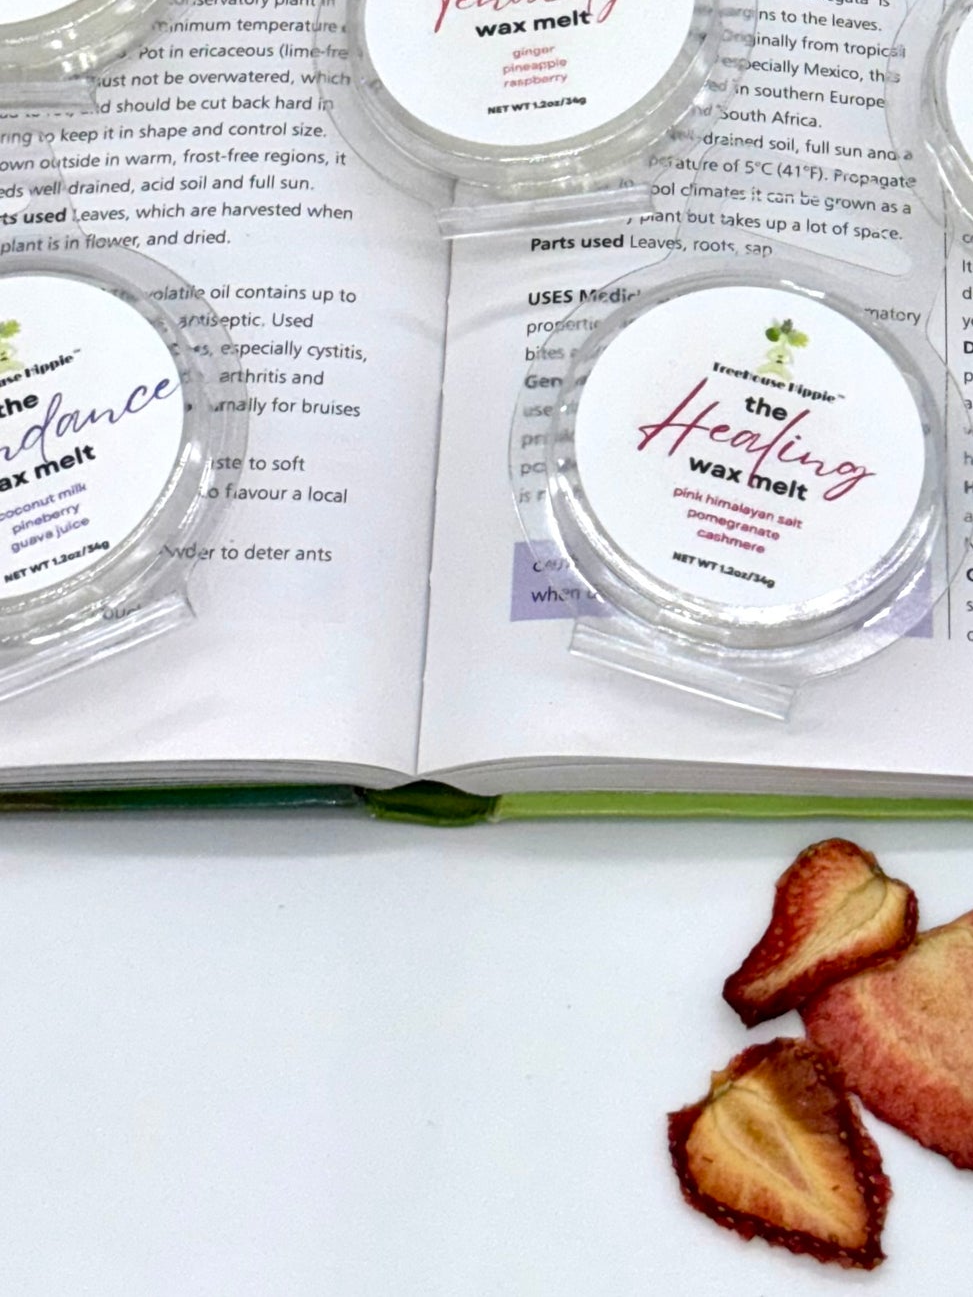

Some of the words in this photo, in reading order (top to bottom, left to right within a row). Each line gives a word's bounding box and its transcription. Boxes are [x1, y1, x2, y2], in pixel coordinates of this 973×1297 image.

[476, 20, 527, 37] wax
[533, 9, 591, 31] melt
[513, 45, 555, 60] ginger
[503, 57, 567, 76] pineapple
[504, 72, 568, 88] raspberry
[488, 104, 509, 115] NET
[513, 102, 531, 112] WT
[60, 128, 98, 143] keep
[103, 127, 113, 141] it
[119, 126, 134, 139] in
[139, 123, 187, 143] shape
[192, 123, 222, 136] and
[228, 122, 287, 137] control
[292, 123, 327, 138] size.
[68, 178, 135, 195] drained,
[141, 177, 174, 193] acid
[180, 176, 206, 191] soil
[212, 175, 243, 191] and
[249, 174, 274, 190] full
[280, 177, 313, 191] sun.
[531, 236, 575, 251] Parts
[581, 234, 624, 249] used
[630, 234, 687, 251] Leaves,
[693, 238, 738, 255] roots,
[745, 241, 773, 258] sap
[745, 397, 787, 421] the
[637, 377, 876, 501] Healing
[0, 470, 29, 492] ax
[35, 444, 96, 480] melt
[689, 456, 743, 483] wax
[748, 472, 808, 501] melt
[58, 481, 87, 500] milk
[12, 501, 81, 535] pineberry
[674, 485, 703, 502] pink
[705, 493, 774, 522] himalayan
[777, 510, 803, 529] salt
[11, 530, 54, 553] guava
[56, 517, 90, 539] juice
[687, 507, 780, 541] pomegranate
[221, 546, 239, 561] to
[244, 544, 291, 561] deter
[295, 546, 332, 562] ants
[697, 527, 765, 554] cashmere
[4, 567, 27, 583] NET
[31, 560, 51, 575] WT
[53, 539, 110, 567] 1.2oz/34g
[672, 551, 697, 564] NET
[698, 558, 718, 572] WT
[720, 564, 775, 589] 1.2oz/34g
